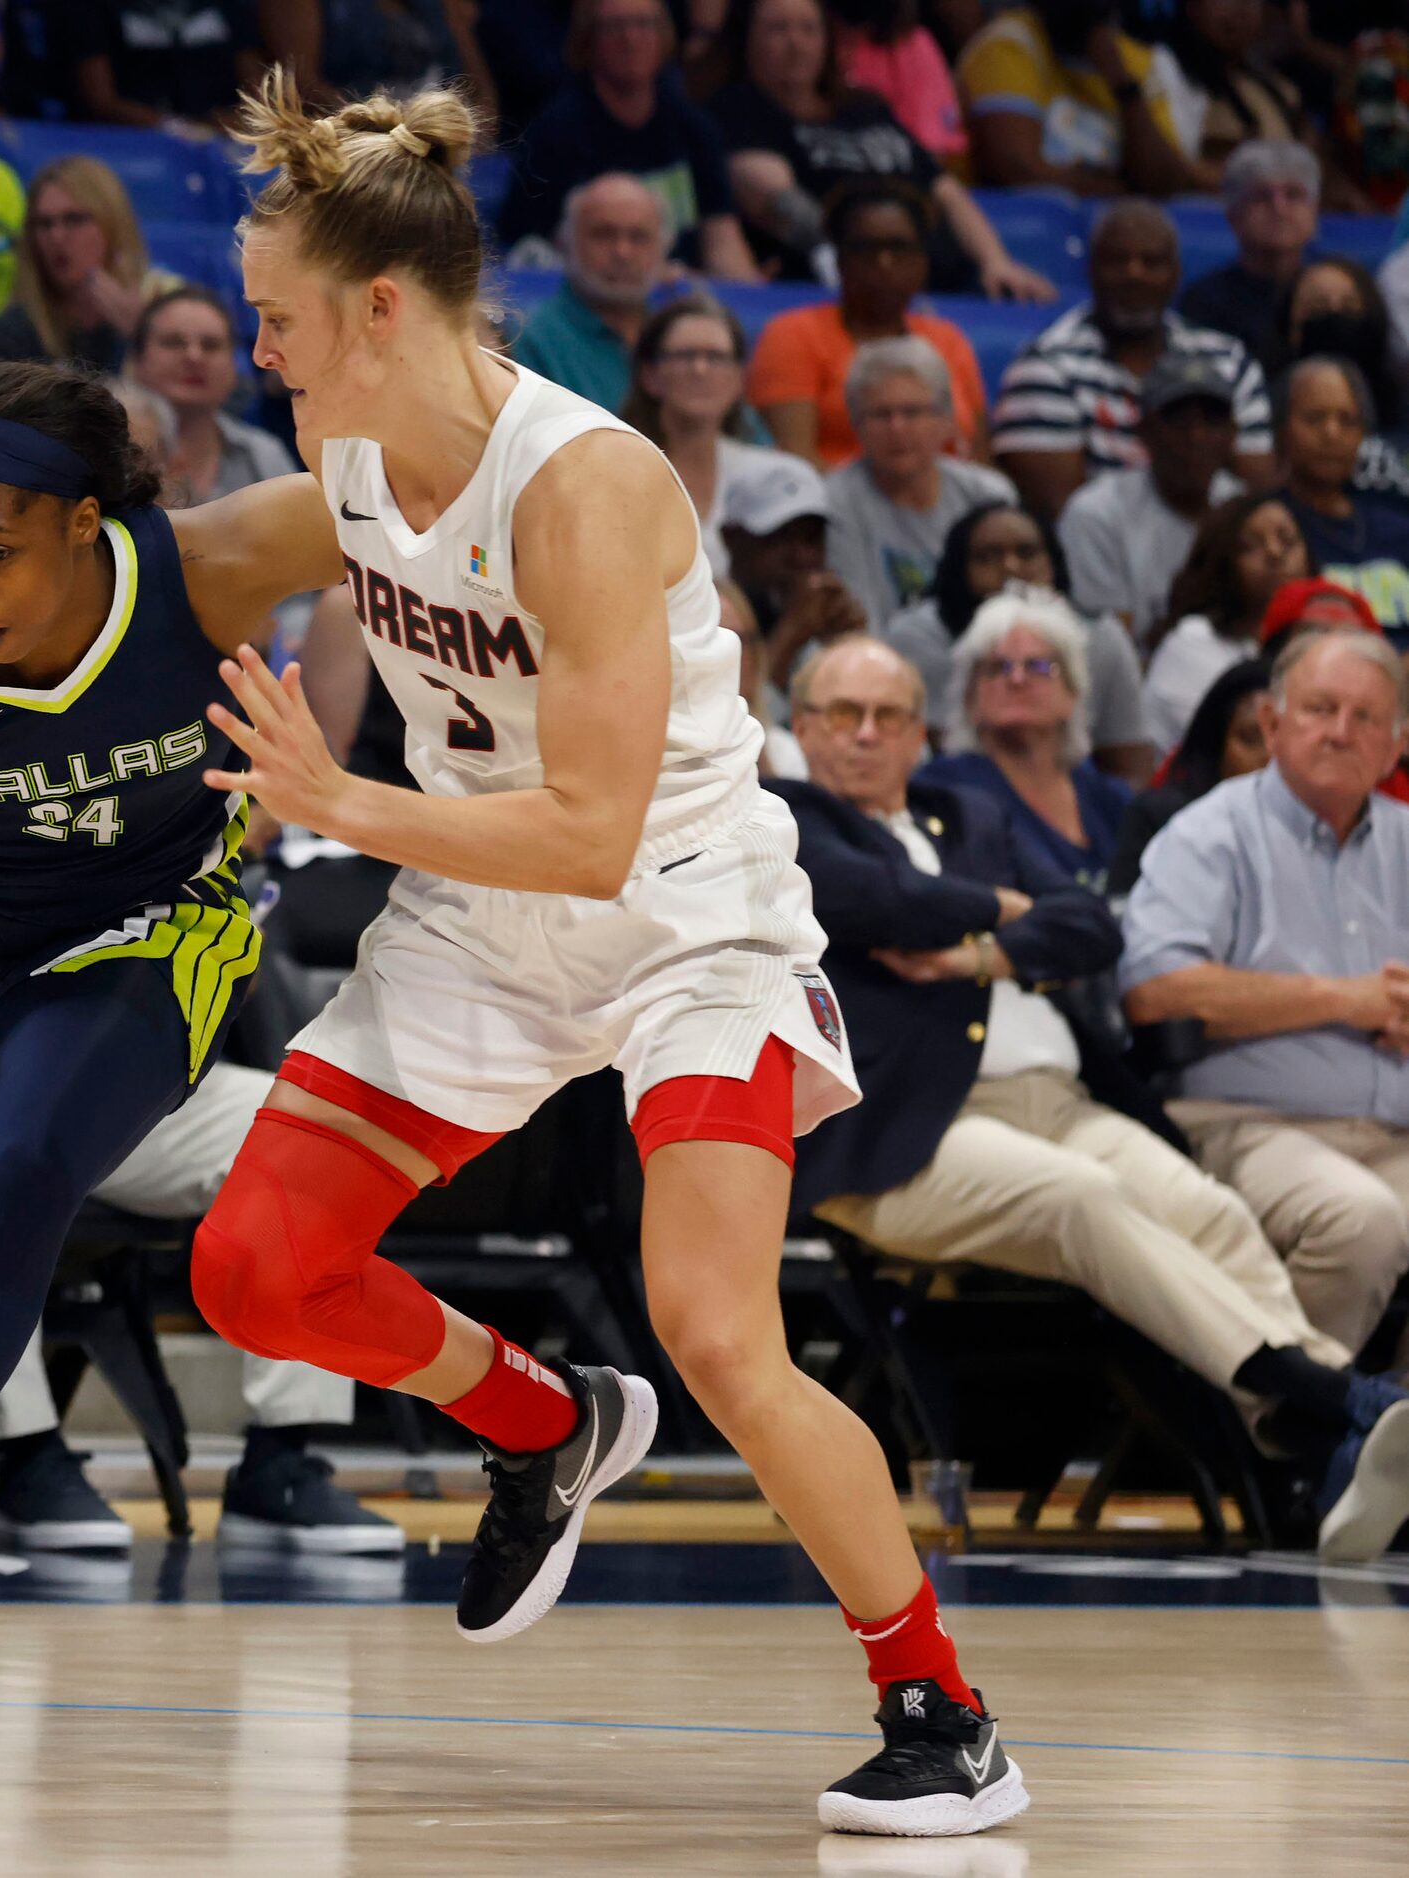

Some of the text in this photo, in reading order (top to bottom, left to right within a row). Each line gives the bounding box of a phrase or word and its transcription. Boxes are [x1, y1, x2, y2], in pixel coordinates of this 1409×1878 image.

[343, 551, 540, 679] DREAM
[460, 574, 505, 600] Microsoft
[418, 670, 495, 752] 3
[21, 796, 124, 846] 24
